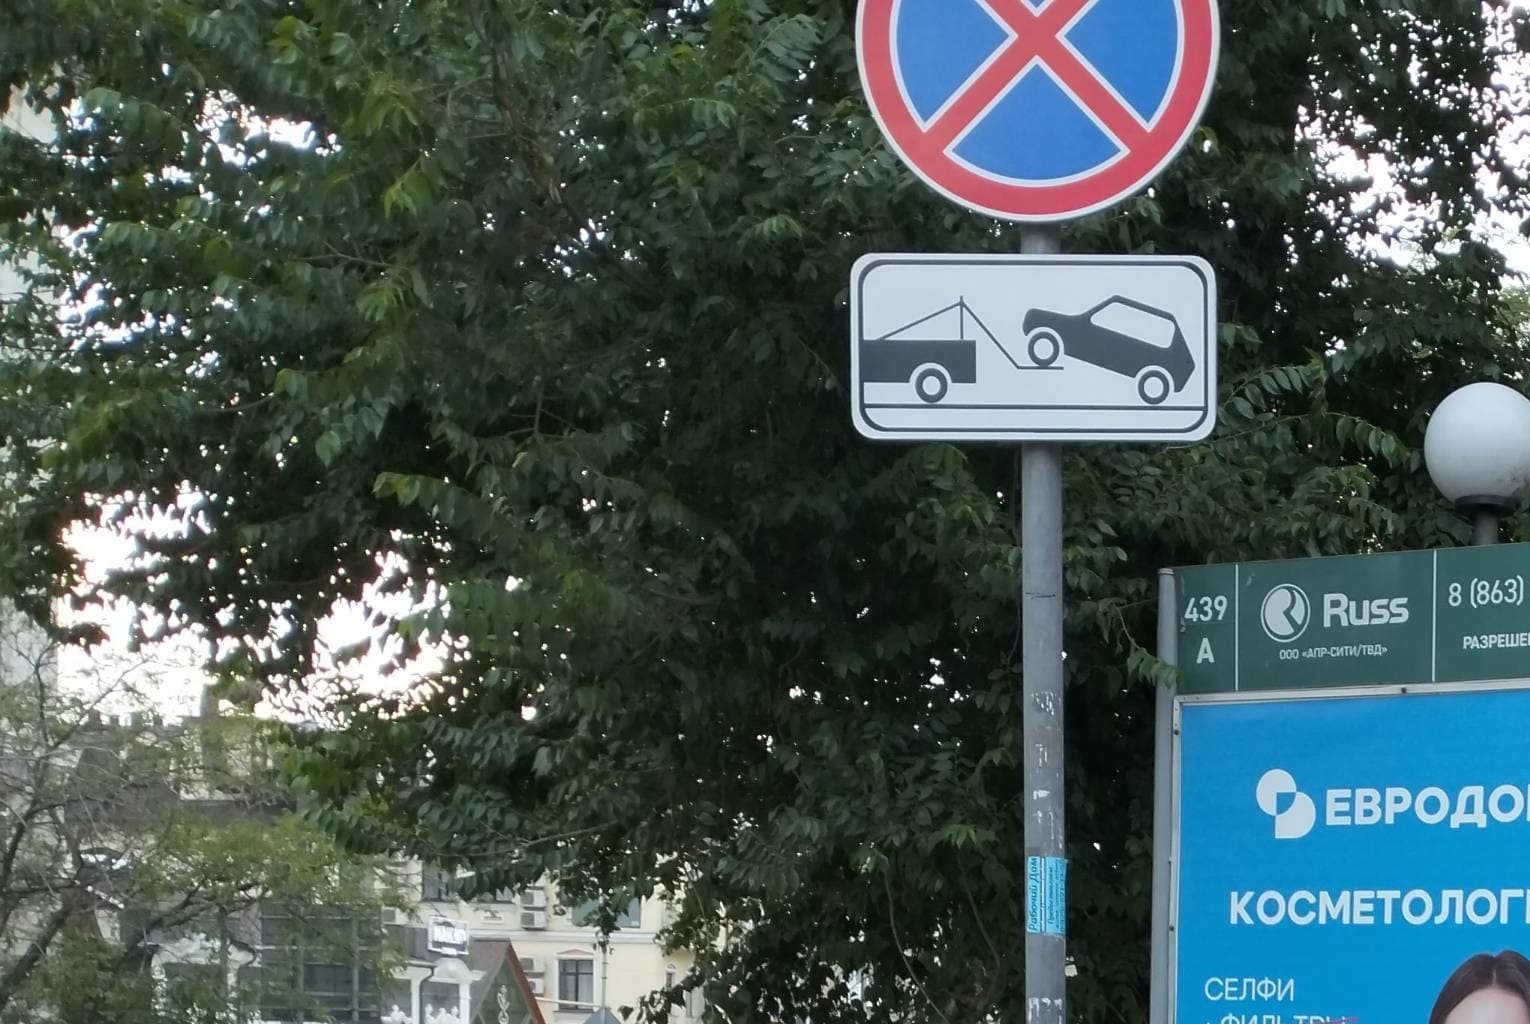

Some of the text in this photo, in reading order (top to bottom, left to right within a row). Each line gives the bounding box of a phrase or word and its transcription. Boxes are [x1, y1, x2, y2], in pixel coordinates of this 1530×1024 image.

[1448, 583, 1462, 607] 8
[1469, 575, 1524, 607] (863)
[1184, 595, 1228, 624] 439
[1323, 592, 1410, 628] Russ
[1279, 648, 1300, 661] ООО
[1204, 976, 1296, 1002] СЕЛФИ
